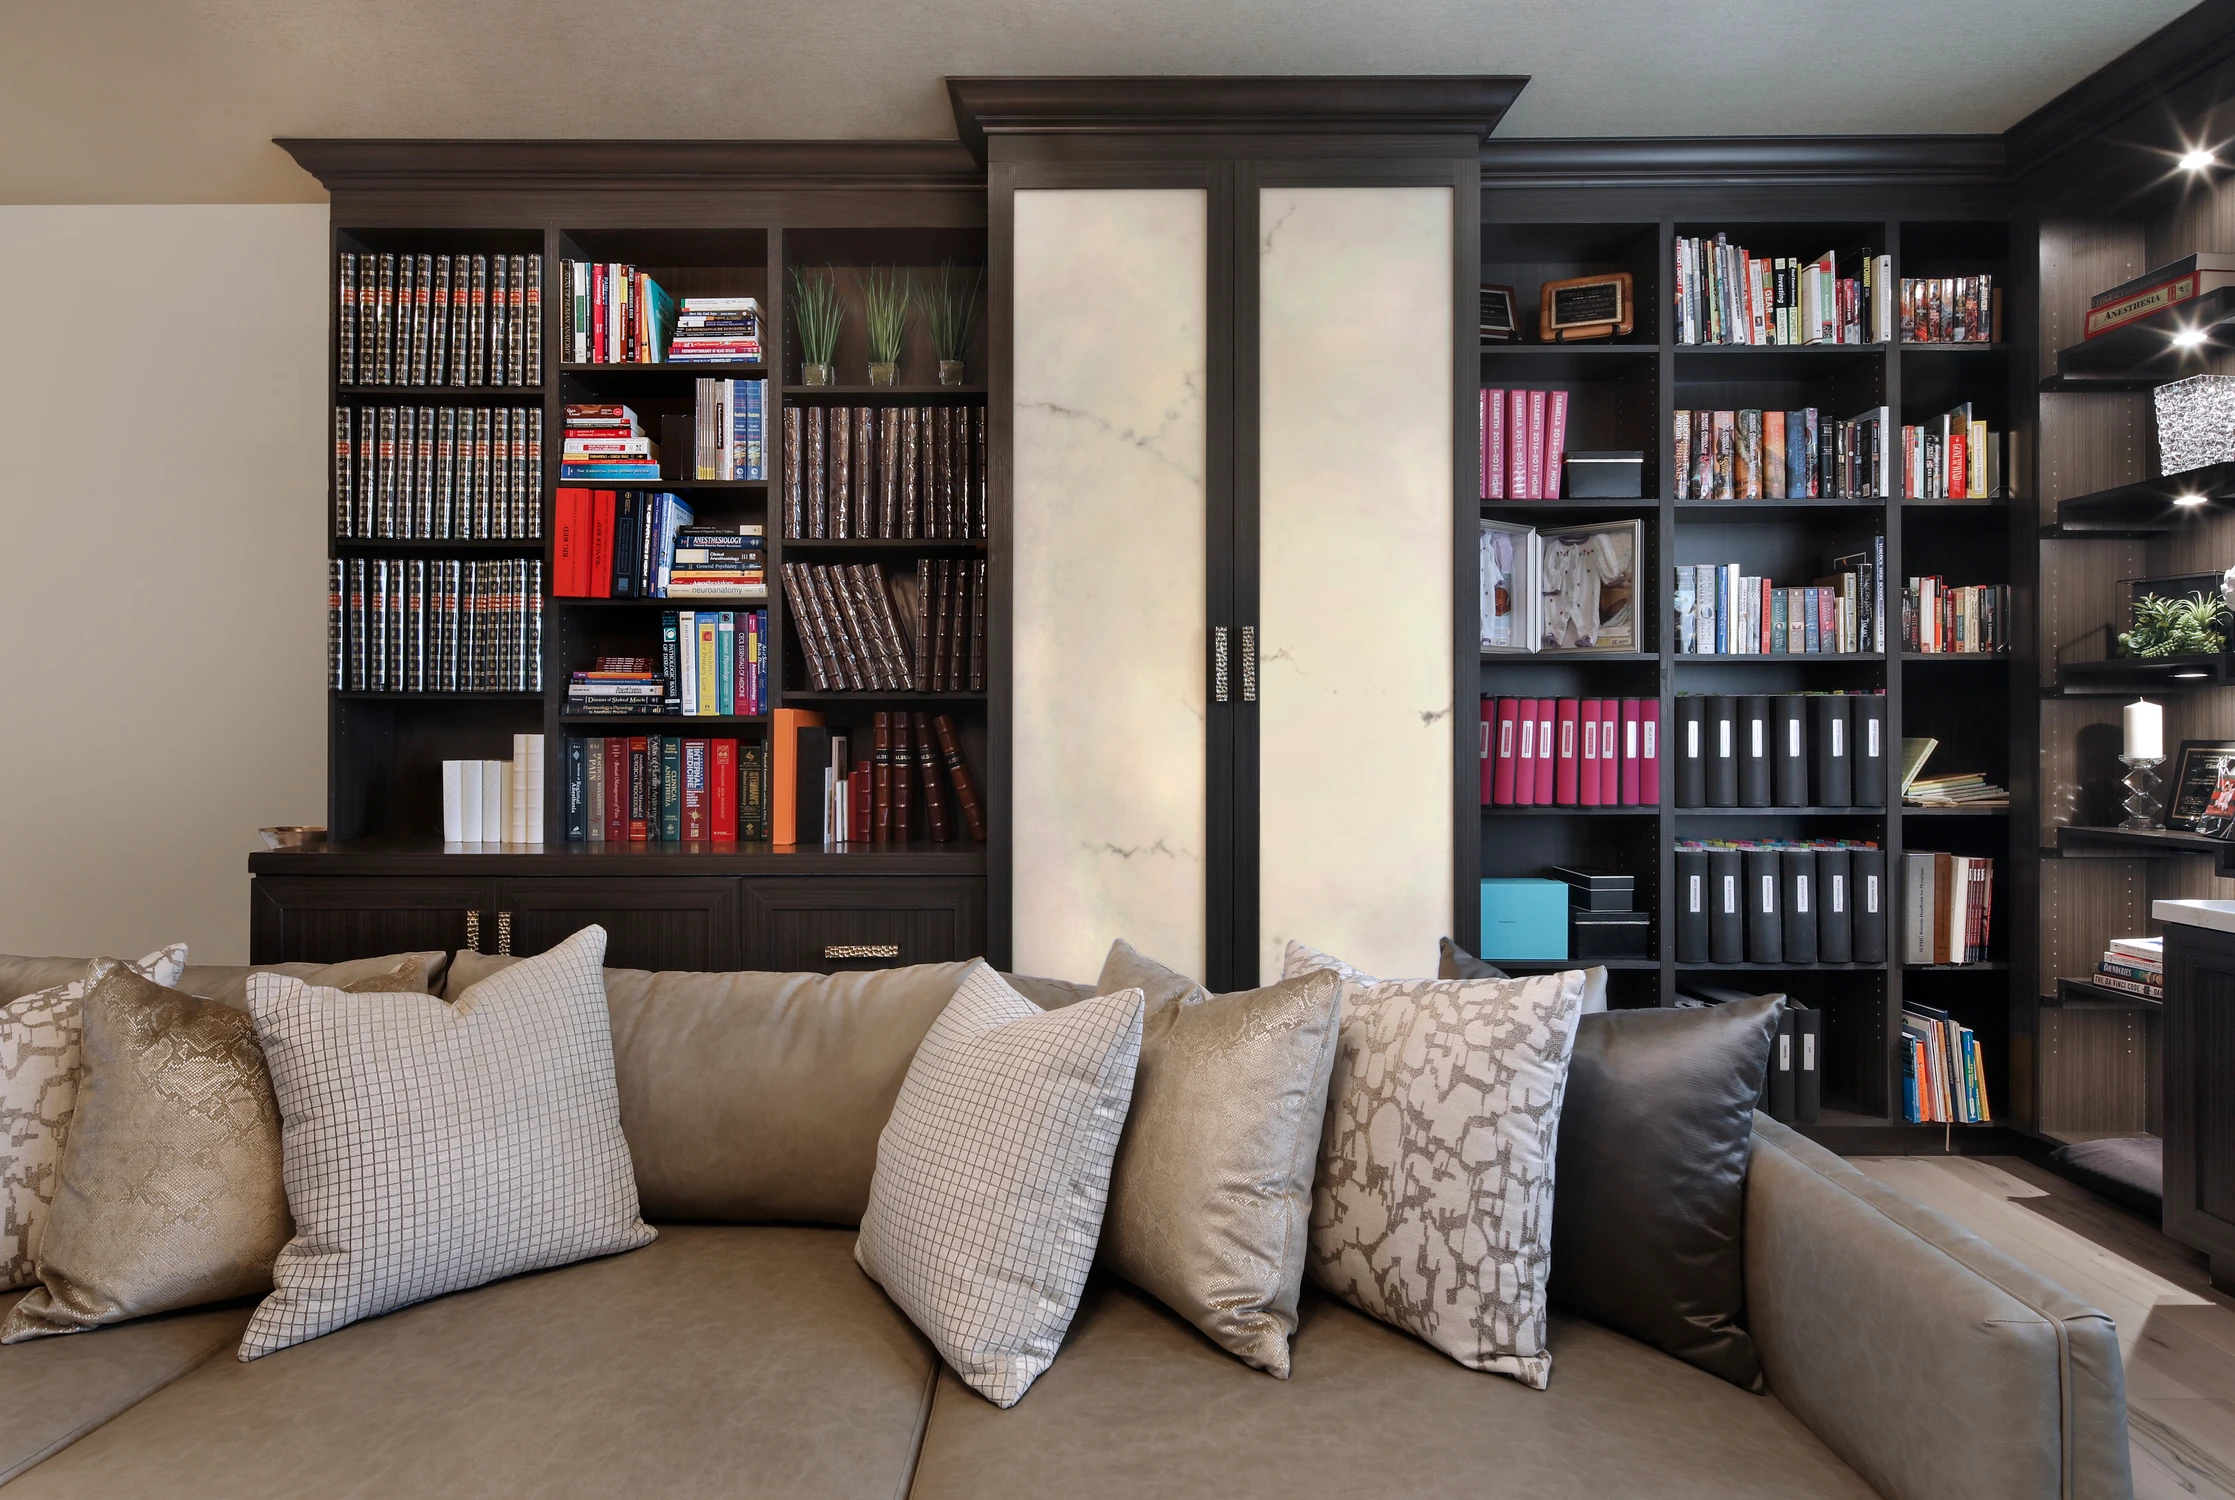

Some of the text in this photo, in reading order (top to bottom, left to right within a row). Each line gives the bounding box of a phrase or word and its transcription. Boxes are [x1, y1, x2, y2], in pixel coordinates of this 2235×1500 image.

[2104, 294, 2160, 321] ANESTHESIA
[1682, 414, 1690, 440] Robert
[1550, 396, 1563, 492] ISABELLA 2016-2017 HOME
[1952, 444, 1962, 481] GONE WIND
[663, 644, 669, 652] OF
[652, 757, 659, 765] of
[749, 772, 760, 805] STEDMAN'S
[2104, 963, 2132, 977] BOUNDARIES
[2095, 976, 2104, 984] THE
[2113, 979, 2126, 989] VINCI
[2127, 982, 2140, 992] CODE
